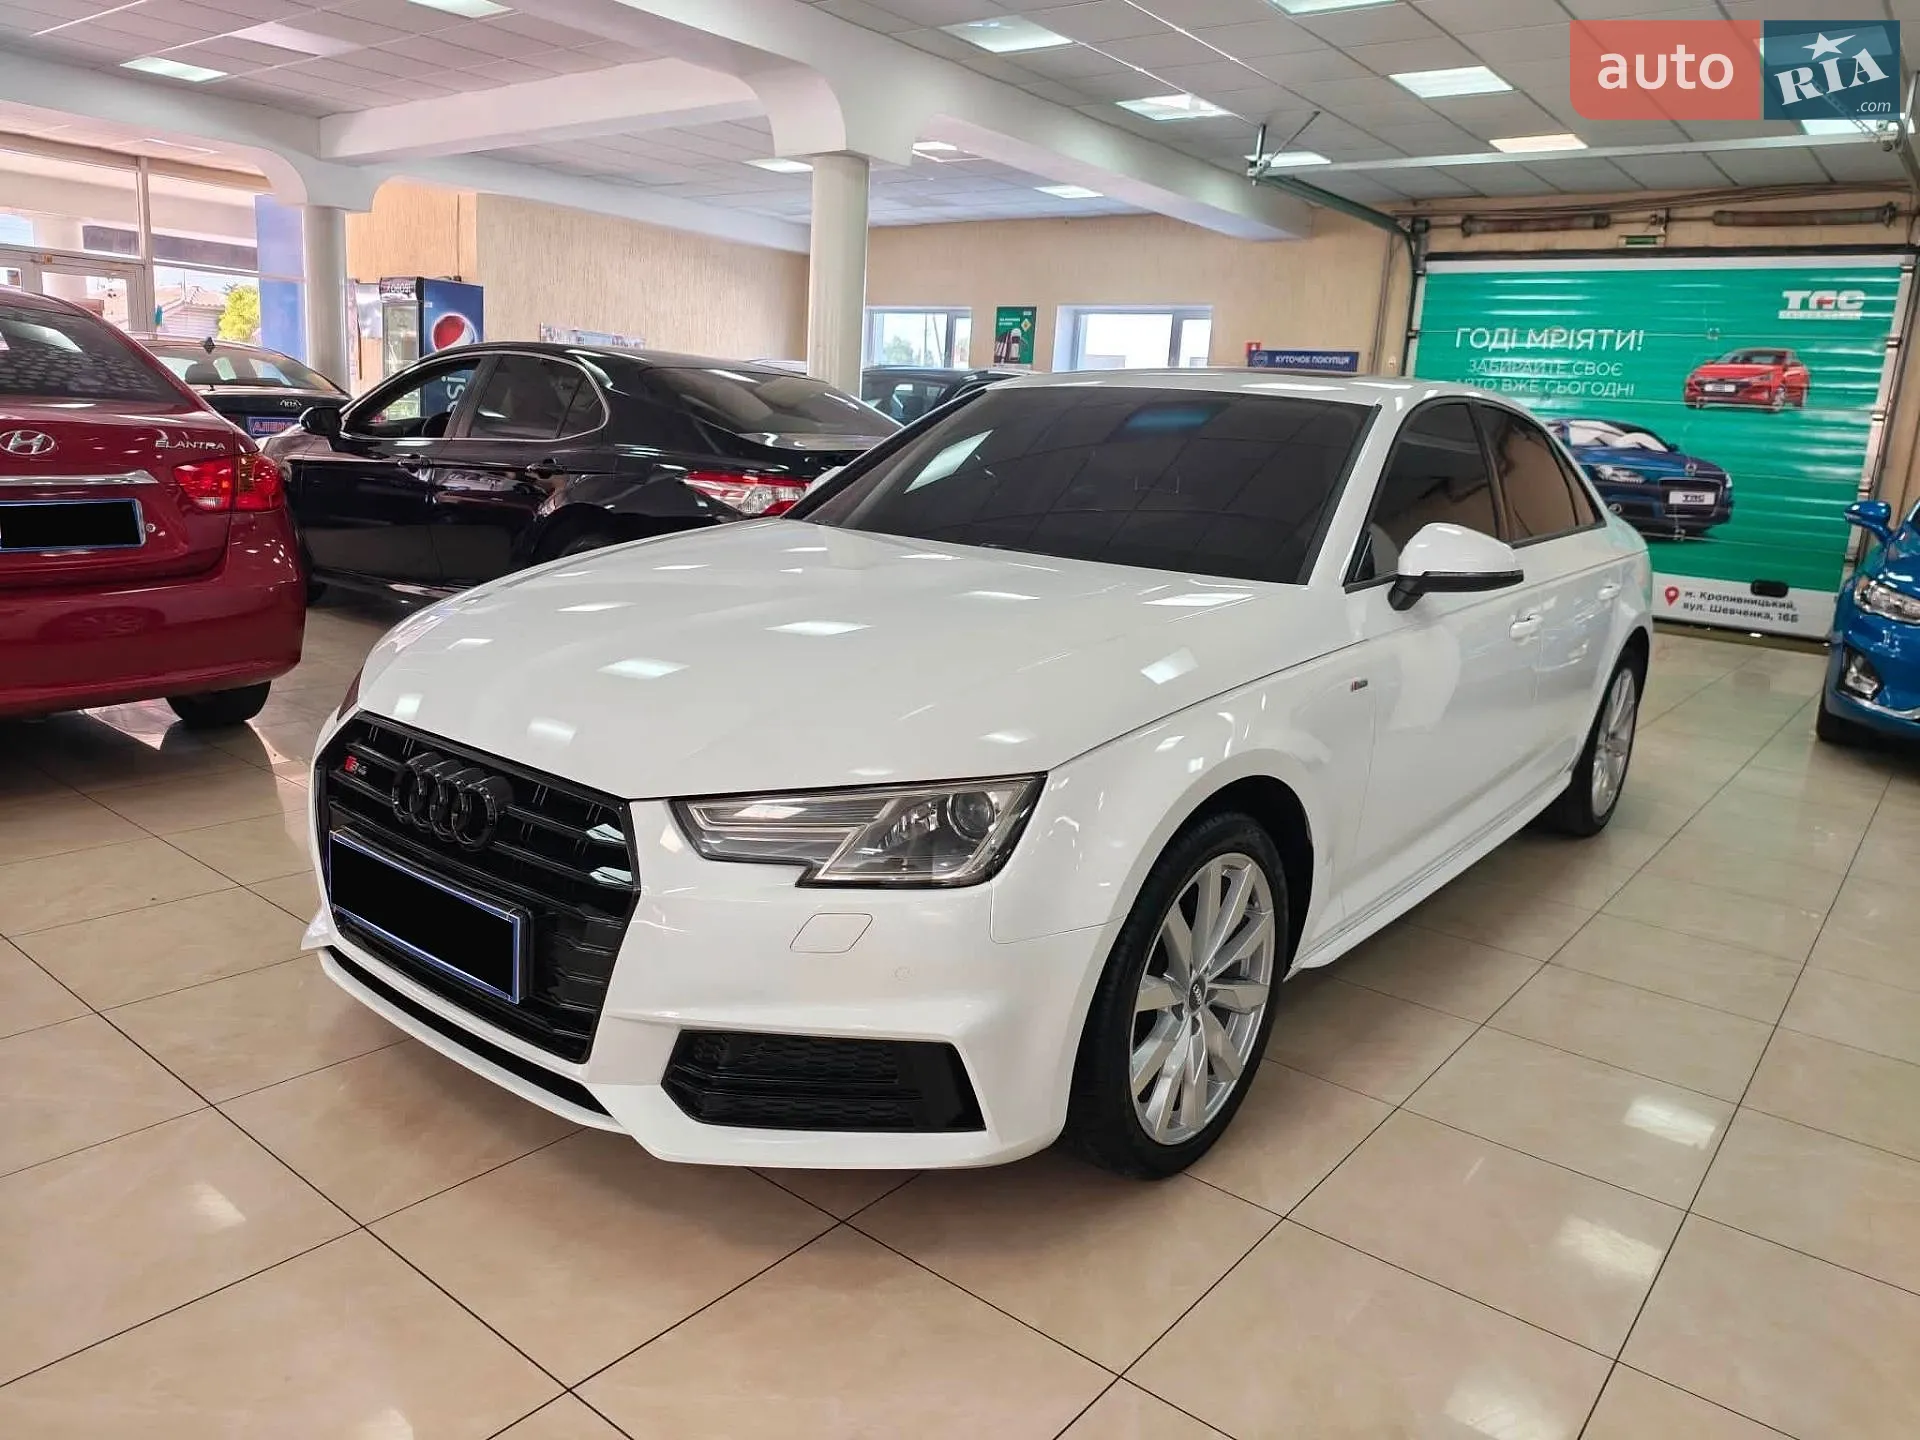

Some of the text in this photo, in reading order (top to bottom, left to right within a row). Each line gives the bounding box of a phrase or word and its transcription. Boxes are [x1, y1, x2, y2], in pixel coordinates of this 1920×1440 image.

[1455, 327, 1645, 352] ГОДІ МРІЯТИ!
[1572, 361, 1624, 377] СВОЄ
[1501, 378, 1541, 393] ВЖЕ
[1544, 380, 1635, 397] СЬОГОДНІ
[154, 440, 226, 450] ELANTRA
